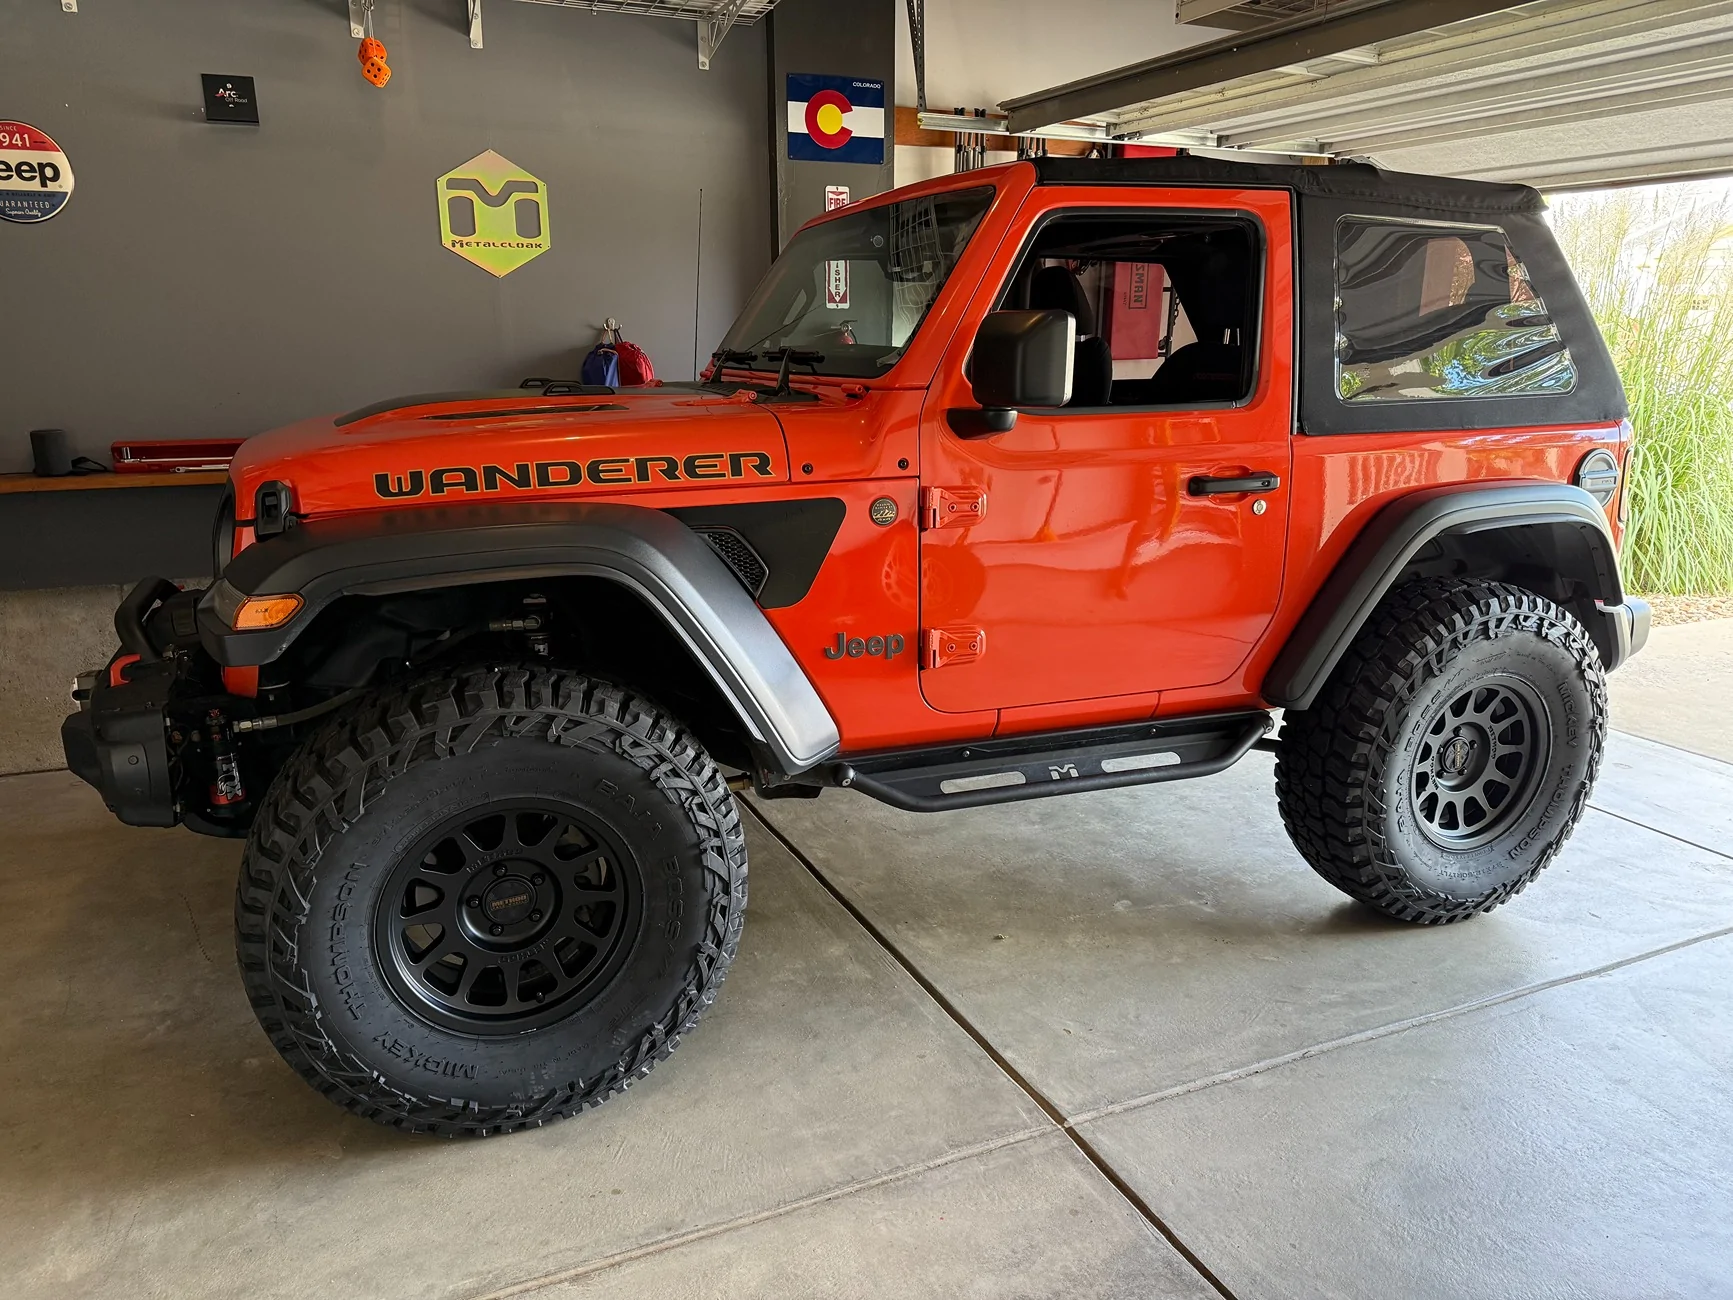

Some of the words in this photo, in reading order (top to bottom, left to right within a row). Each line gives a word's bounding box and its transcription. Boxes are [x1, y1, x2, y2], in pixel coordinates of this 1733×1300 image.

[852, 81, 881, 89] COLORADO
[373, 451, 776, 500] WANDERER
[825, 632, 905, 661] Jeep
[1557, 681, 1579, 749] MICKEY
[1509, 762, 1575, 860] THOMPSON
[327, 861, 371, 1021] THOMPSON
[373, 1029, 479, 1080] MICKEY
